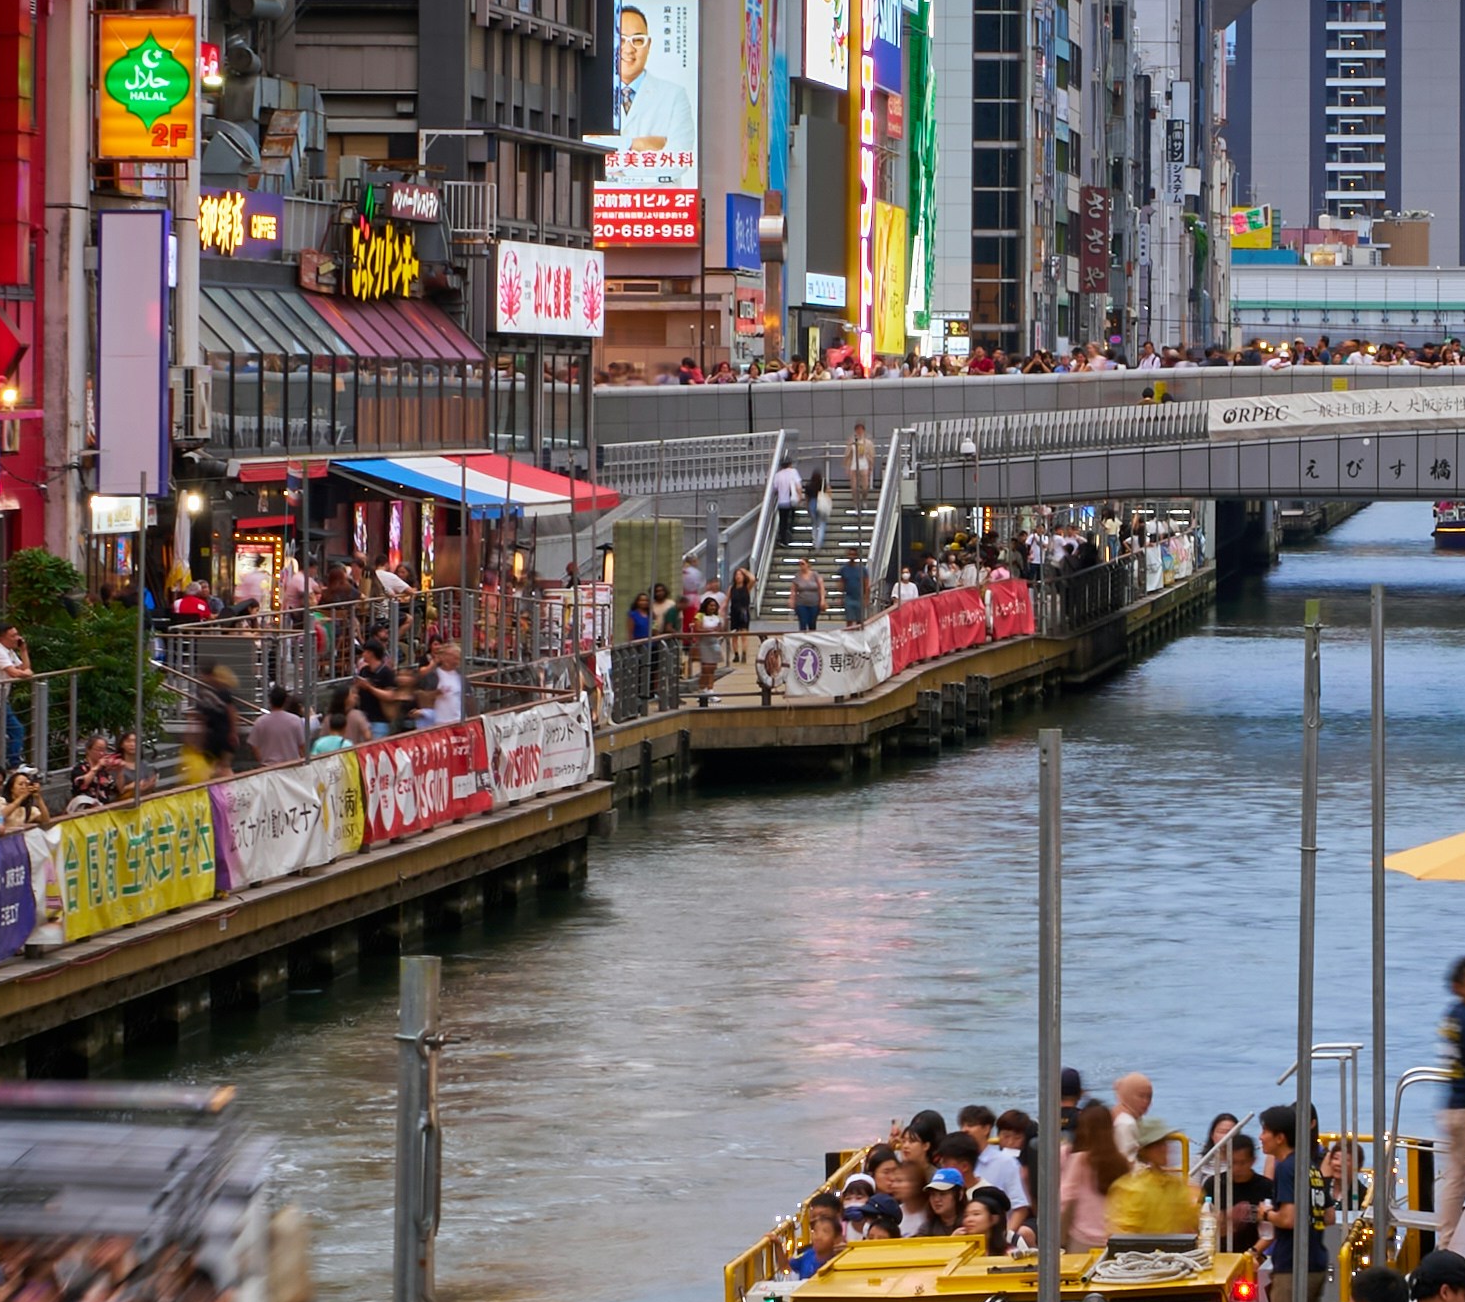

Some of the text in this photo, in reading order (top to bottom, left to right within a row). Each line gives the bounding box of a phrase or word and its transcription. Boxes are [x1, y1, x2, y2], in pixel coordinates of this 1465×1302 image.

[124, 64, 171, 91] حلال
[130, 91, 168, 102] HALAL
[151, 123, 188, 147] 2F
[607, 151, 695, 169] 京美容外科
[675, 194, 696, 208] 2F
[198, 191, 278, 255] 珈琲店 COFFEE
[593, 224, 696, 238] 20-658-958
[1086, 191, 1106, 290] ささや
[1223, 405, 1290, 424] ORPEC
[1301, 399, 1399, 419] 一般社団法人
[1304, 457, 1453, 482] えびす橋
